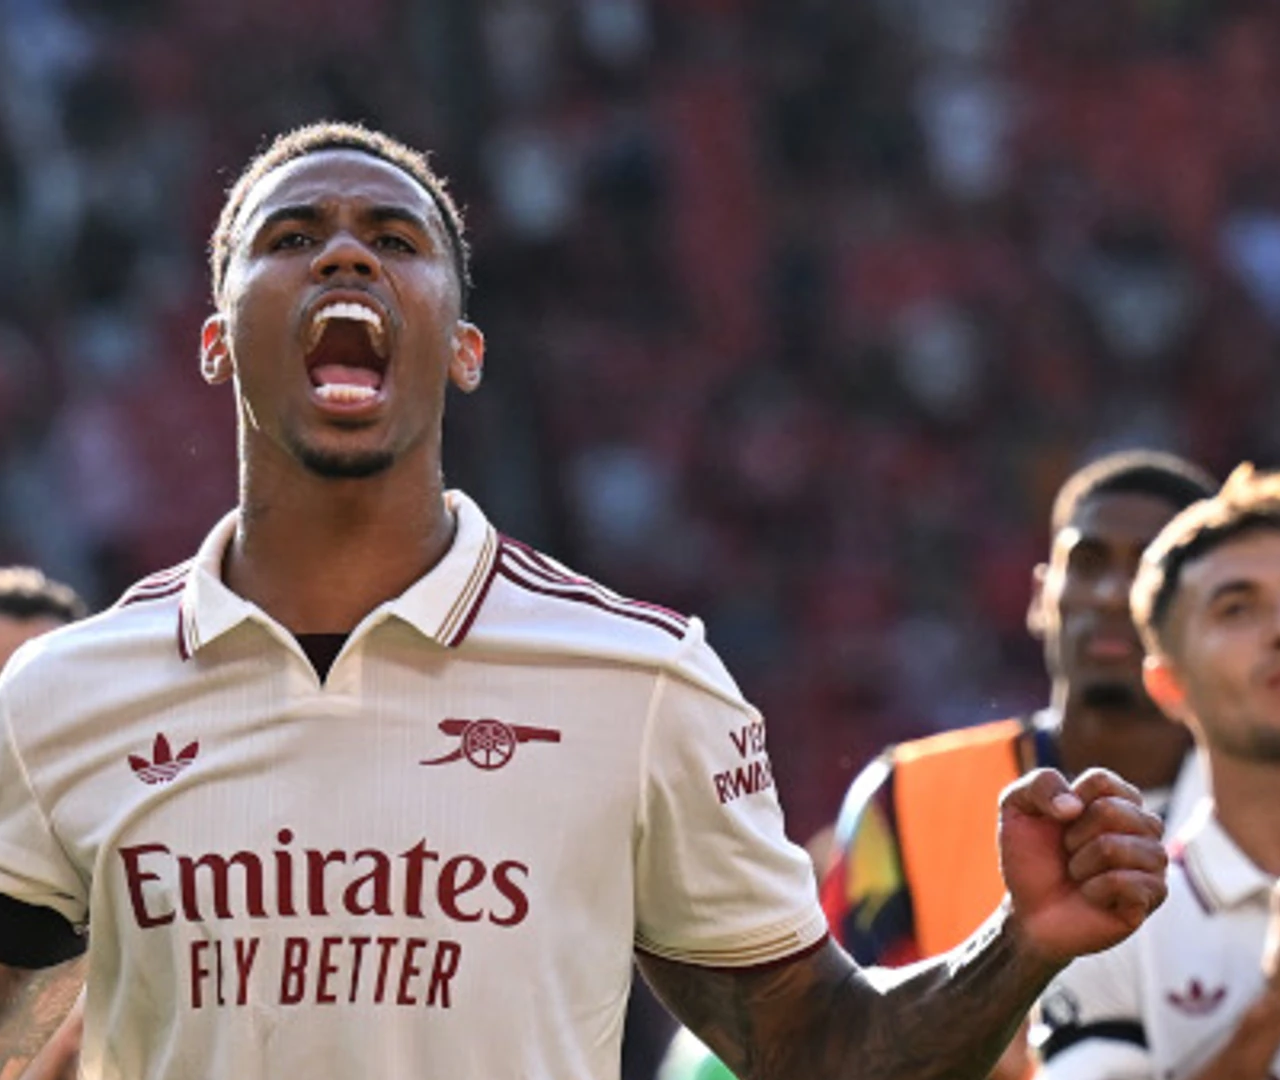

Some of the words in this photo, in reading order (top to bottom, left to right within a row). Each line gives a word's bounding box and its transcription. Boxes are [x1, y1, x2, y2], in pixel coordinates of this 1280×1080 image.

[118, 828, 530, 928] Emirates
[190, 937, 261, 1009] FLY
[279, 937, 463, 1009] BETTER
